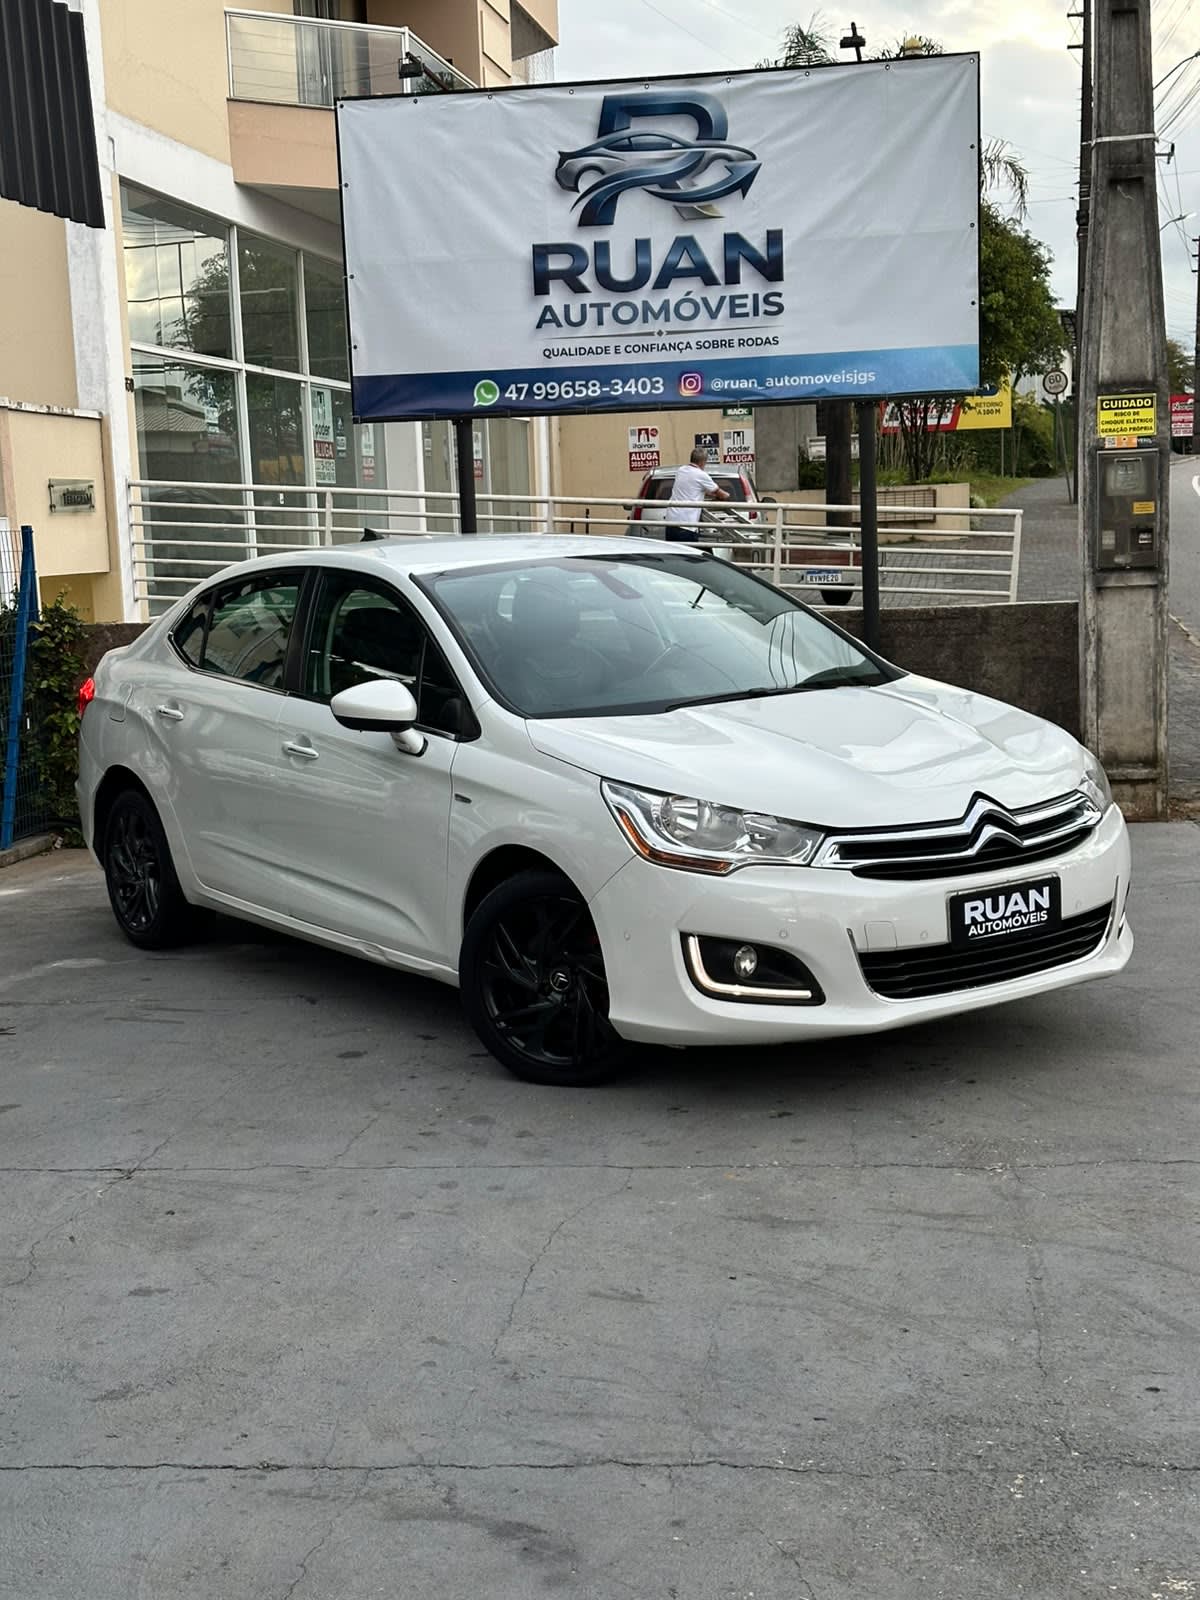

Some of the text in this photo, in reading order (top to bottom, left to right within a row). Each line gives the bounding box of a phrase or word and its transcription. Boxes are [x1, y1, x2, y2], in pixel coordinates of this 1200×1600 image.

[532, 229, 784, 296] RUAN
[535, 290, 785, 329] AUTOMÓVEIS
[543, 336, 779, 358] QUALIDADE E CONFIANÇA SOBRE RODAS
[504, 377, 664, 401] 47 99658-3403
[711, 370, 876, 392] @ruan_automoveisjgs
[1049, 374, 1061, 384] 60
[1103, 398, 1152, 409] CUIDADO
[631, 452, 658, 461] ALUGA
[725, 455, 753, 463] ALUGA
[727, 446, 750, 454] poder
[964, 886, 1050, 925] RUAN
[968, 910, 1048, 937] AUTOMÓVEIS
